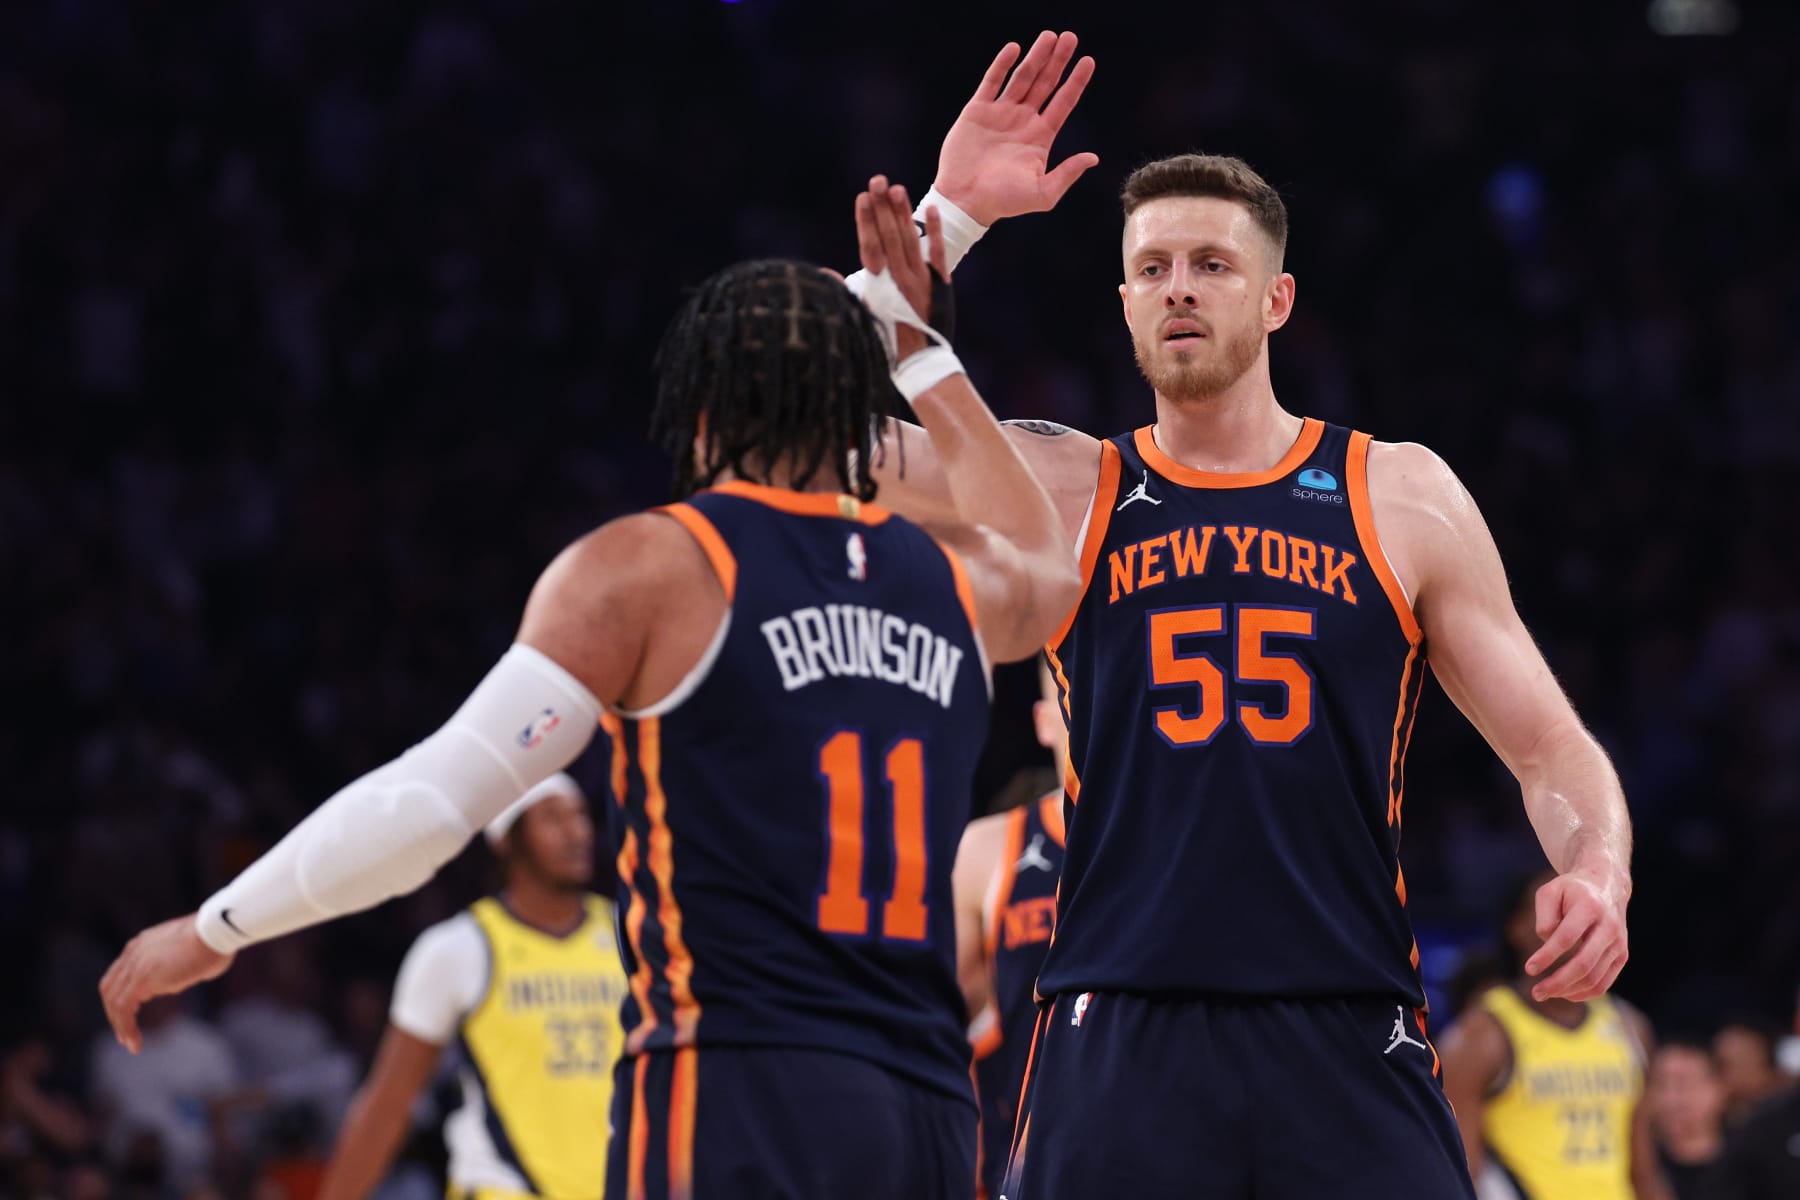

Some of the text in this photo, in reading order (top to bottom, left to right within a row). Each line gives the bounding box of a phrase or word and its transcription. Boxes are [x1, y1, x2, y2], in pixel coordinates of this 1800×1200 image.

[1292, 488, 1343, 503] sphere
[1108, 526, 1358, 606] NEW YORK
[760, 603, 964, 708] BRUNSON
[1146, 603, 1318, 748] 55
[816, 729, 930, 942] 11
[1003, 897, 1057, 950] NE
[546, 1016, 609, 1076] 33
